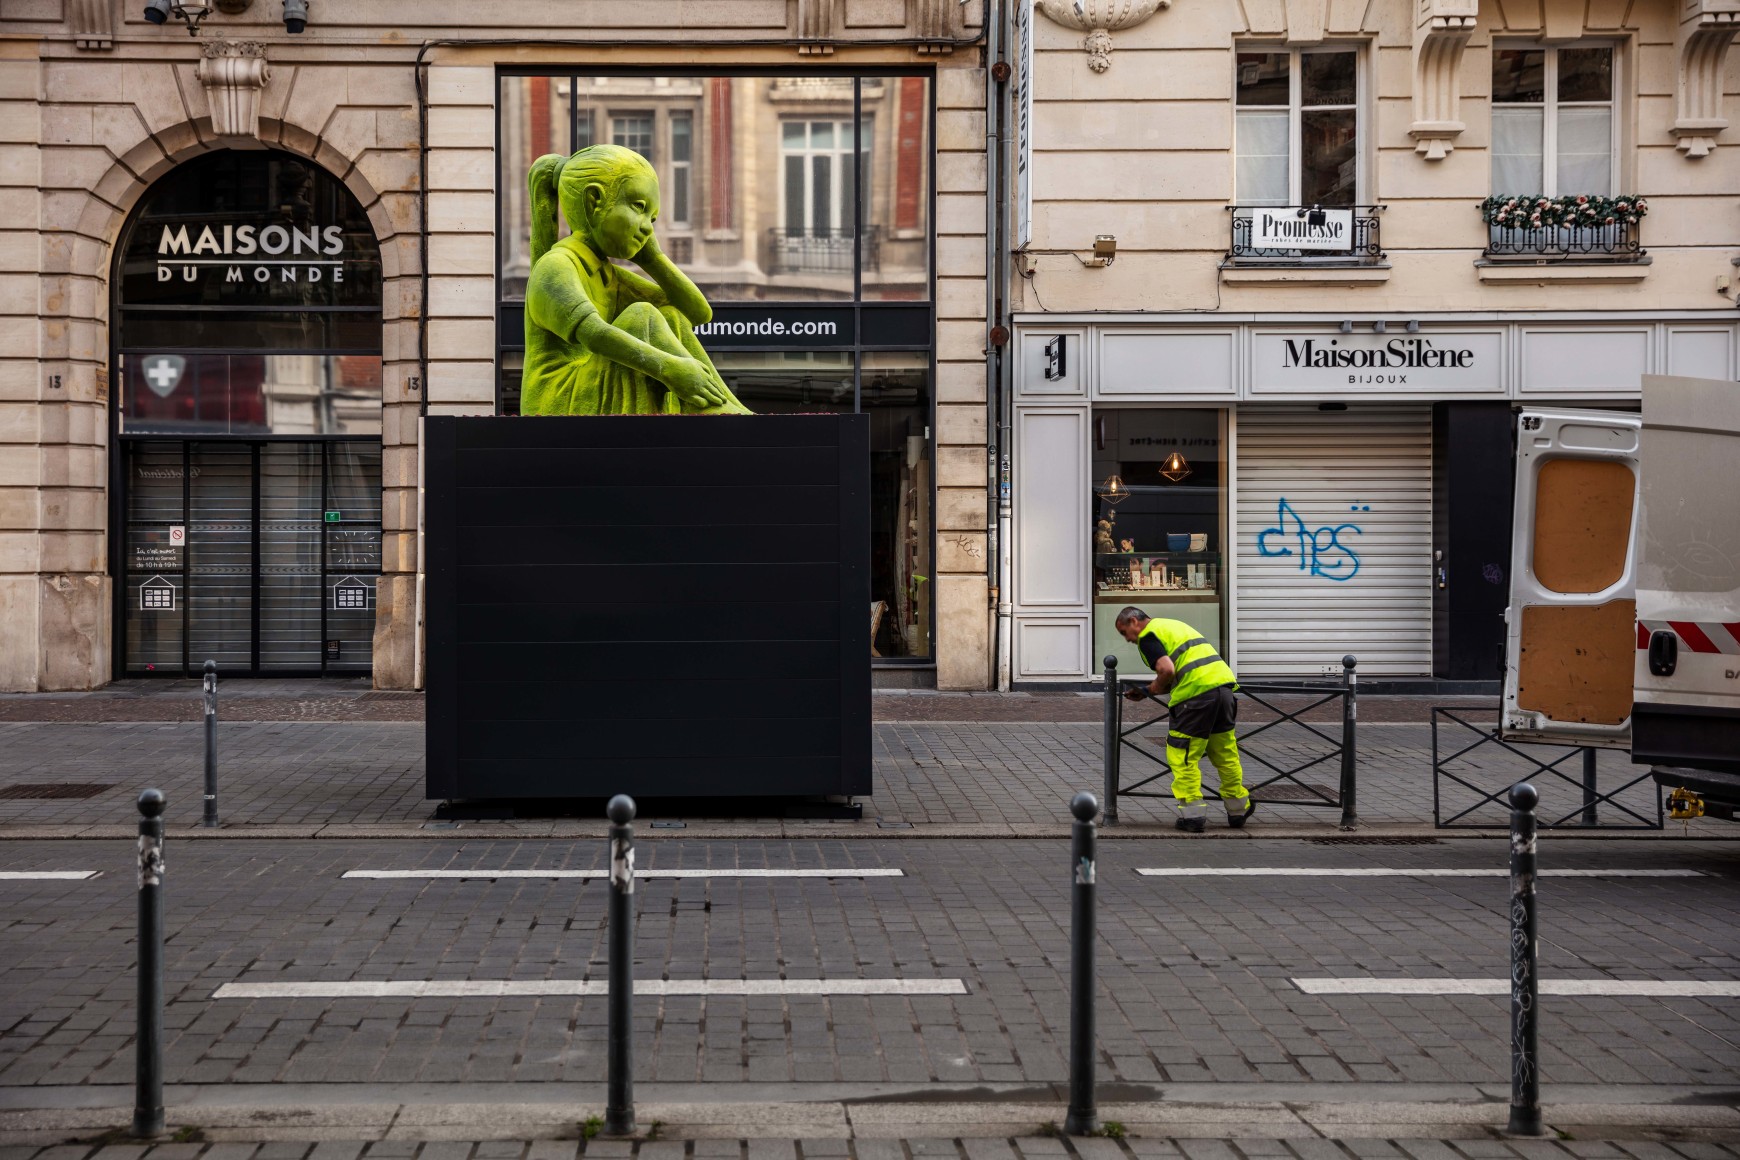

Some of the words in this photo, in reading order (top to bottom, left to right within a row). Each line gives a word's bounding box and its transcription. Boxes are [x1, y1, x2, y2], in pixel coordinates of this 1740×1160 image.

[1263, 214, 1343, 238] Promesse
[158, 225, 344, 255] MAISONS
[157, 266, 197, 282] DU
[226, 266, 344, 282] MONDE
[1282, 337, 1474, 368] MaisonSilène
[49, 375, 62, 389] 13
[407, 377, 420, 391] 13
[1348, 374, 1408, 384] BIJOUX
